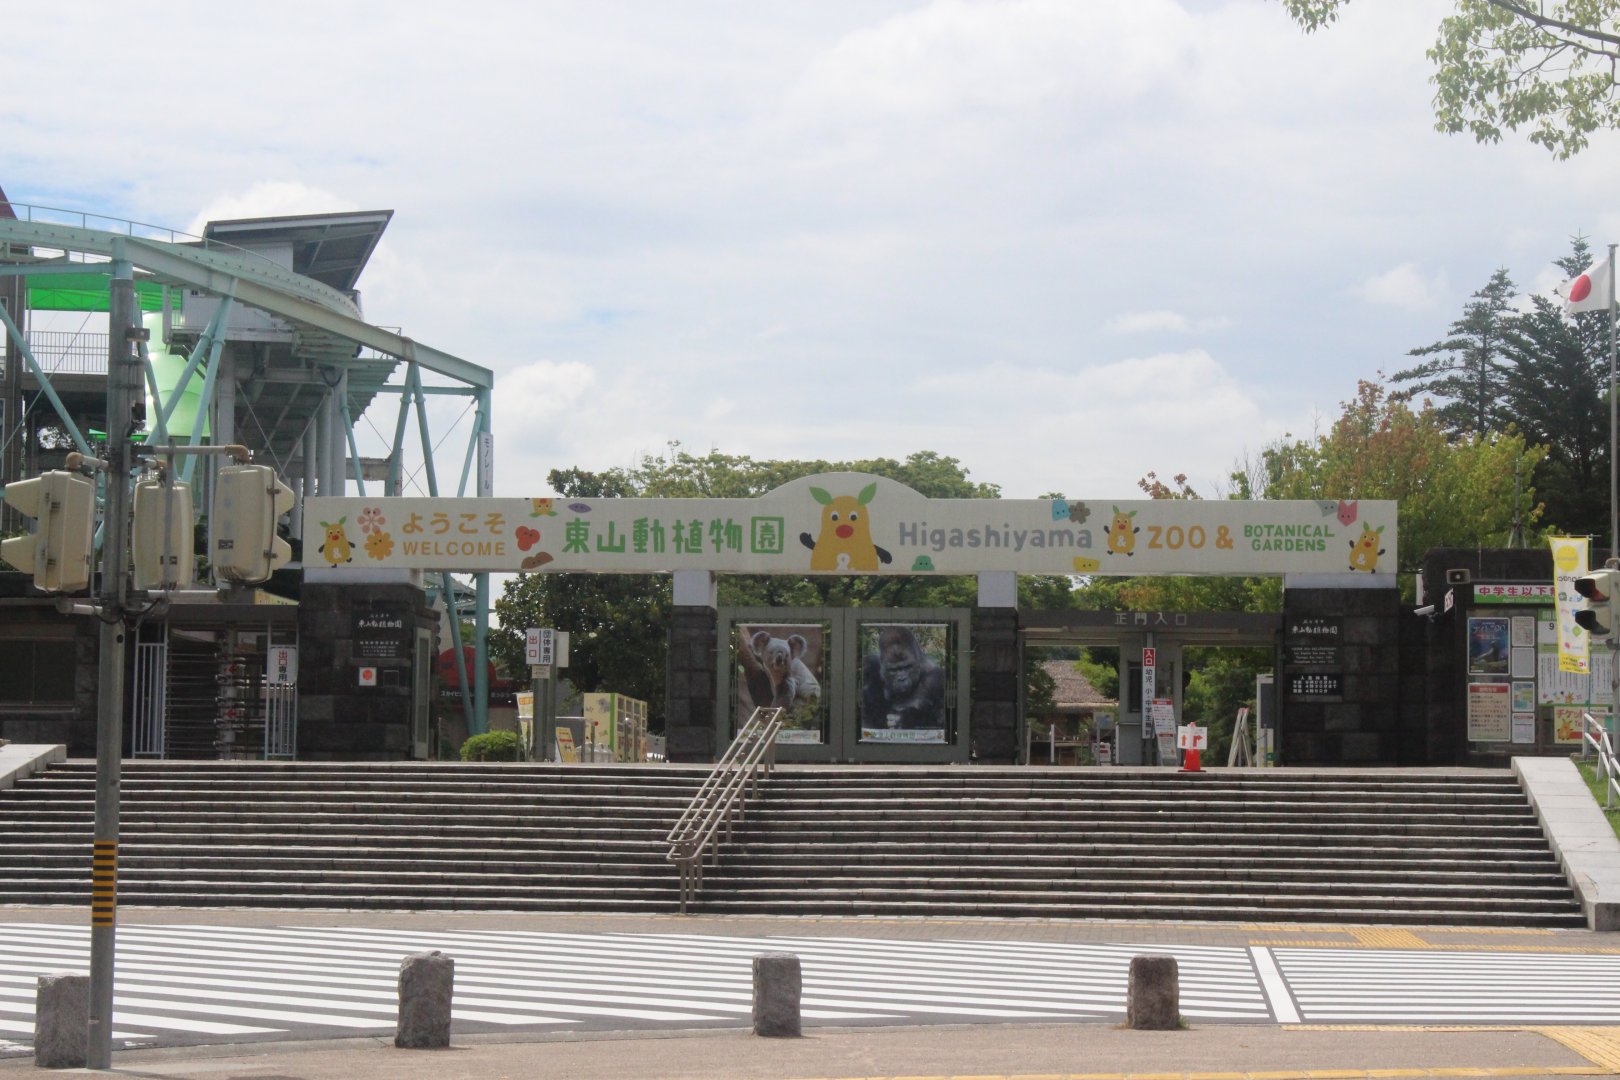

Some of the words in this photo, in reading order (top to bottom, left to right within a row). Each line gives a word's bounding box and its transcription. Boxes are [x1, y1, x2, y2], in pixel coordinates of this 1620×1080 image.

[402, 512, 506, 534] ようこそ
[1243, 524, 1335, 538] BOTANICAL
[562, 516, 785, 554] 東山動植物園
[899, 521, 1093, 552] Higashiyama
[1147, 525, 1206, 550] ZOO
[1215, 525, 1234, 550] &
[403, 541, 506, 556] WELCOME
[1251, 538, 1326, 551] GARDENS
[1114, 612, 1187, 626] 正門入口
[528, 635, 537, 658] 出口
[1145, 650, 1153, 666] 入口
